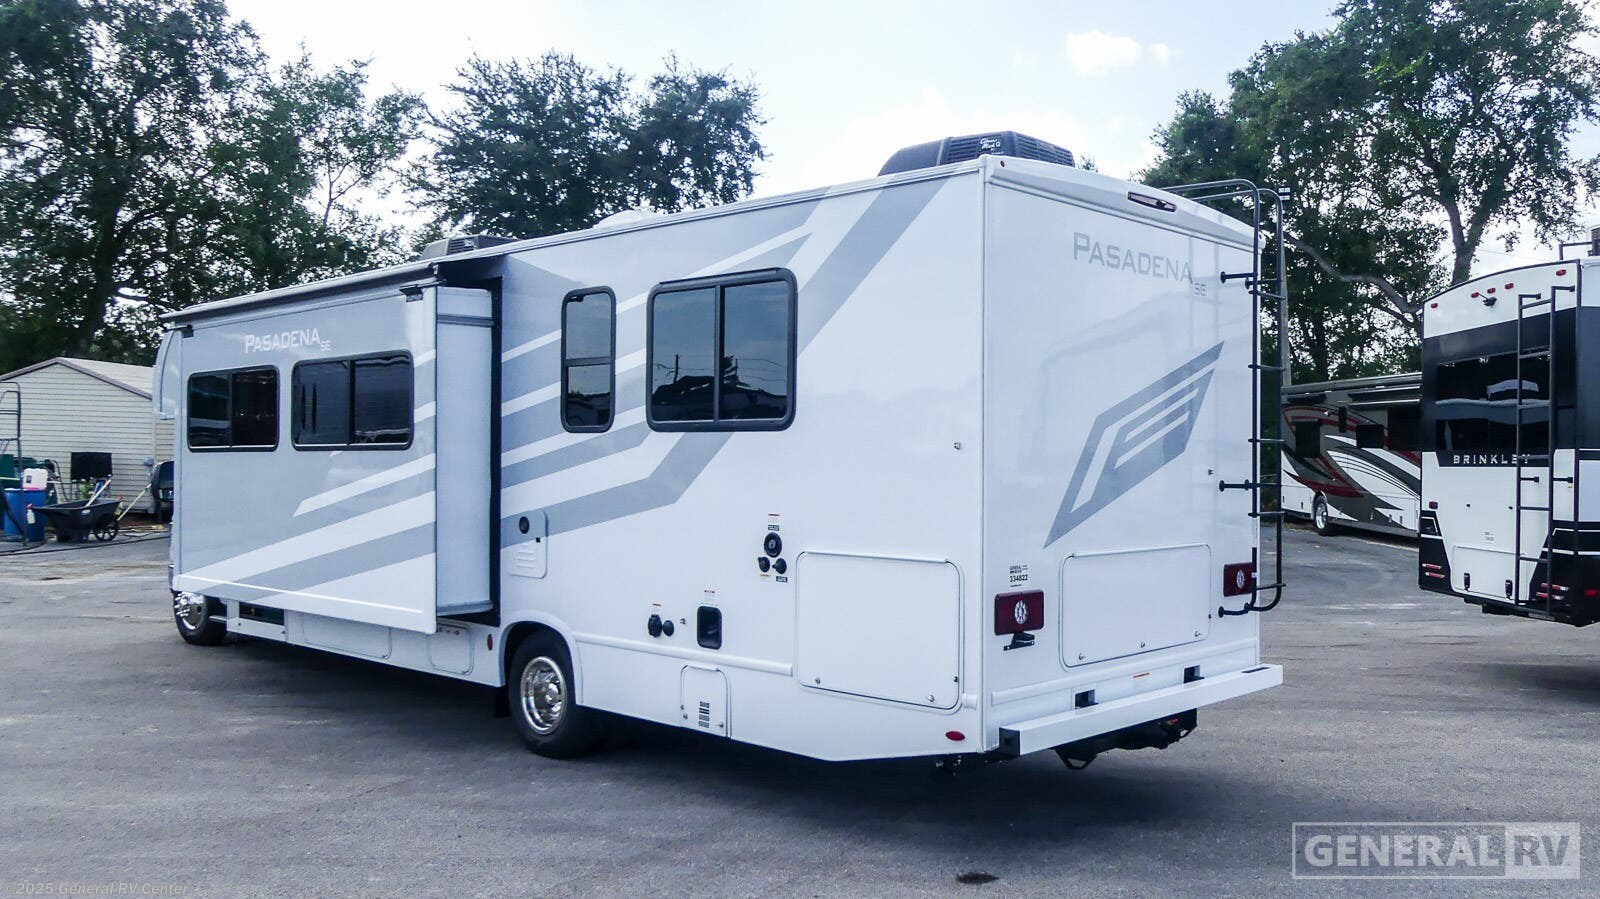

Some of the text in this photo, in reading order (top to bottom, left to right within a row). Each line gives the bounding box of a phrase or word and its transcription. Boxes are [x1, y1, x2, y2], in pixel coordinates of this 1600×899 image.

[1073, 231, 1207, 297] PASADENA SE
[245, 328, 320, 353] PASADENA
